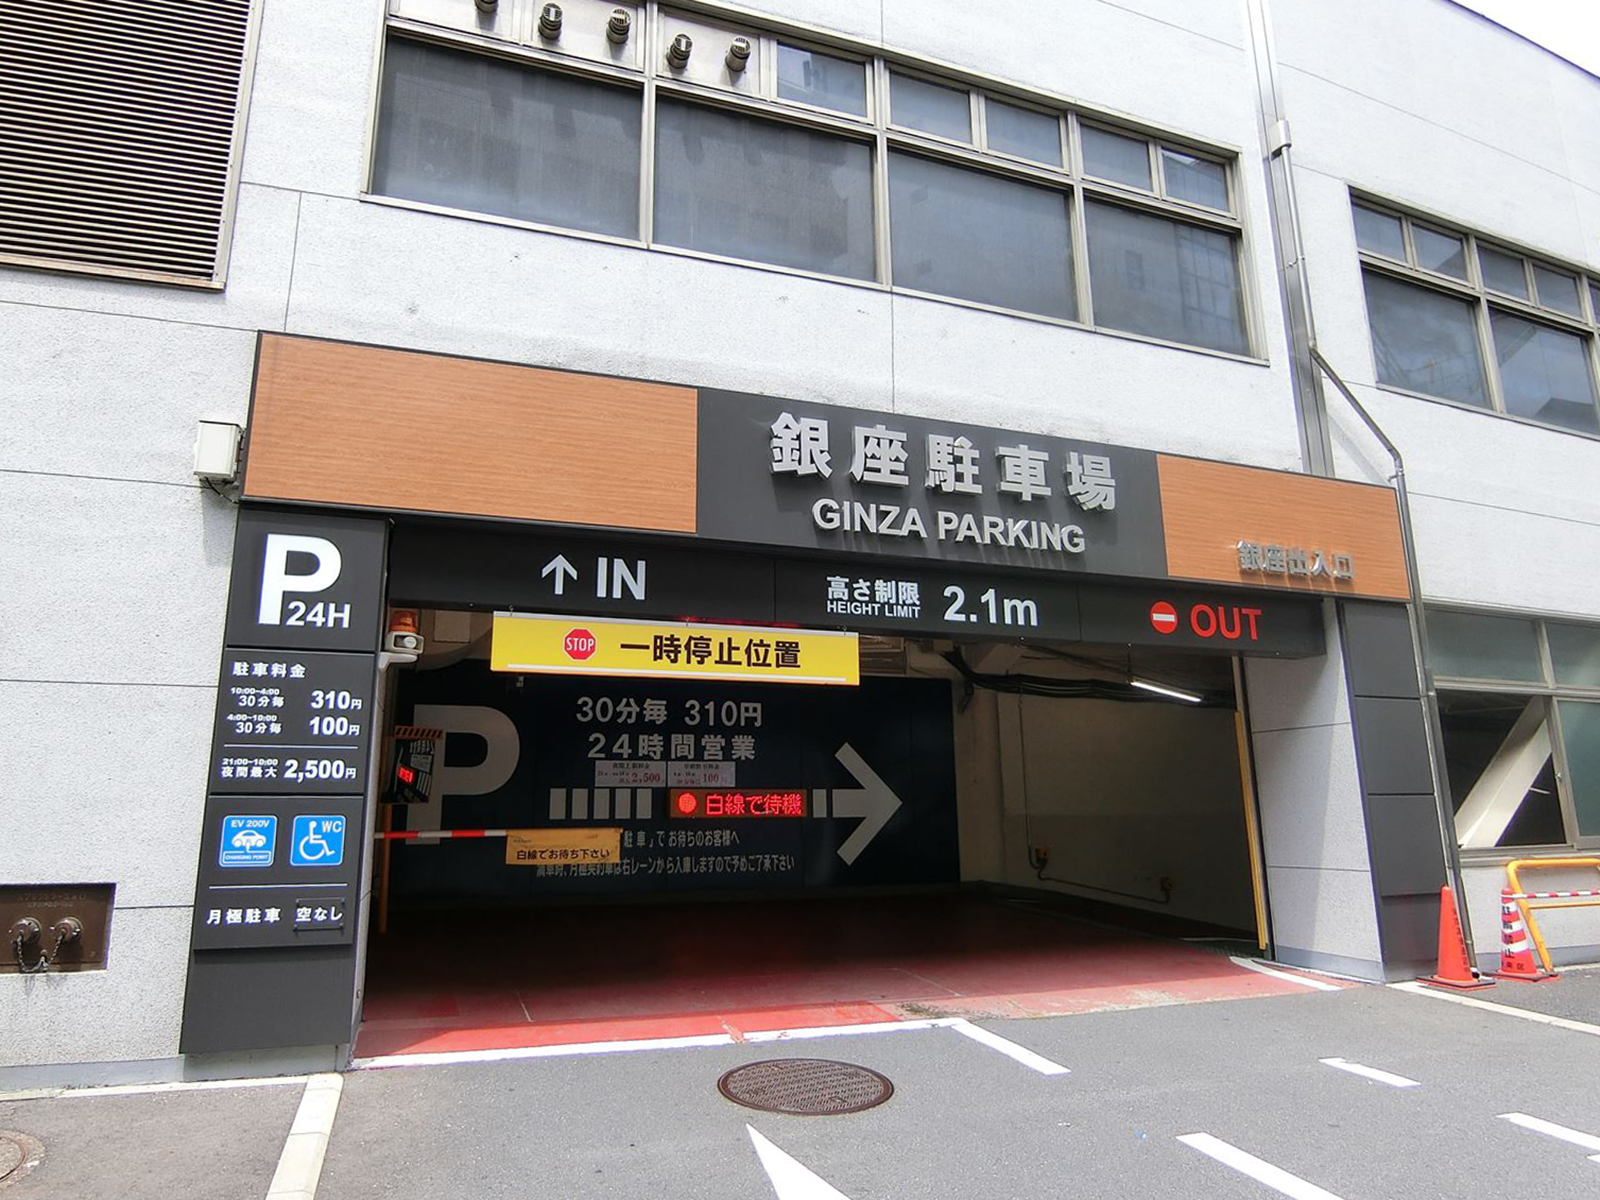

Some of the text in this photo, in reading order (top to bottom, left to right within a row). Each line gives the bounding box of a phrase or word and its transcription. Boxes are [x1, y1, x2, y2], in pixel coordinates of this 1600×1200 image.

[770, 412, 1116, 511] 銀座駐車場
[812, 498, 1086, 554] GINZA PARKING
[1237, 541, 1355, 580] 銀座出入口
[258, 533, 342, 625] P
[596, 556, 647, 601] IN
[827, 575, 921, 606] 高さ制限
[285, 600, 351, 629] 24H
[826, 600, 921, 620] HEIGHT LIMIT
[943, 585, 1039, 627] 2.1m
[1190, 603, 1263, 641] OUT
[566, 637, 595, 652] STOP
[620, 634, 802, 669] 一時停止位置
[232, 661, 306, 679] 駐車料金
[238, 690, 362, 710] 30分毎 310円
[576, 696, 763, 728] 30分毎 310円
[235, 716, 360, 736] 30分毎 100円
[587, 732, 756, 761] 24時間営業
[221, 759, 357, 783] 夜間最大 2,500円
[405, 704, 521, 845] P
[705, 793, 803, 816] 白線で待機
[231, 820, 270, 828] EV 200V
[321, 820, 342, 833] WC
[517, 848, 610, 860] 白線でお待ち下さい
[206, 906, 343, 925] 月極駐車 空なし
